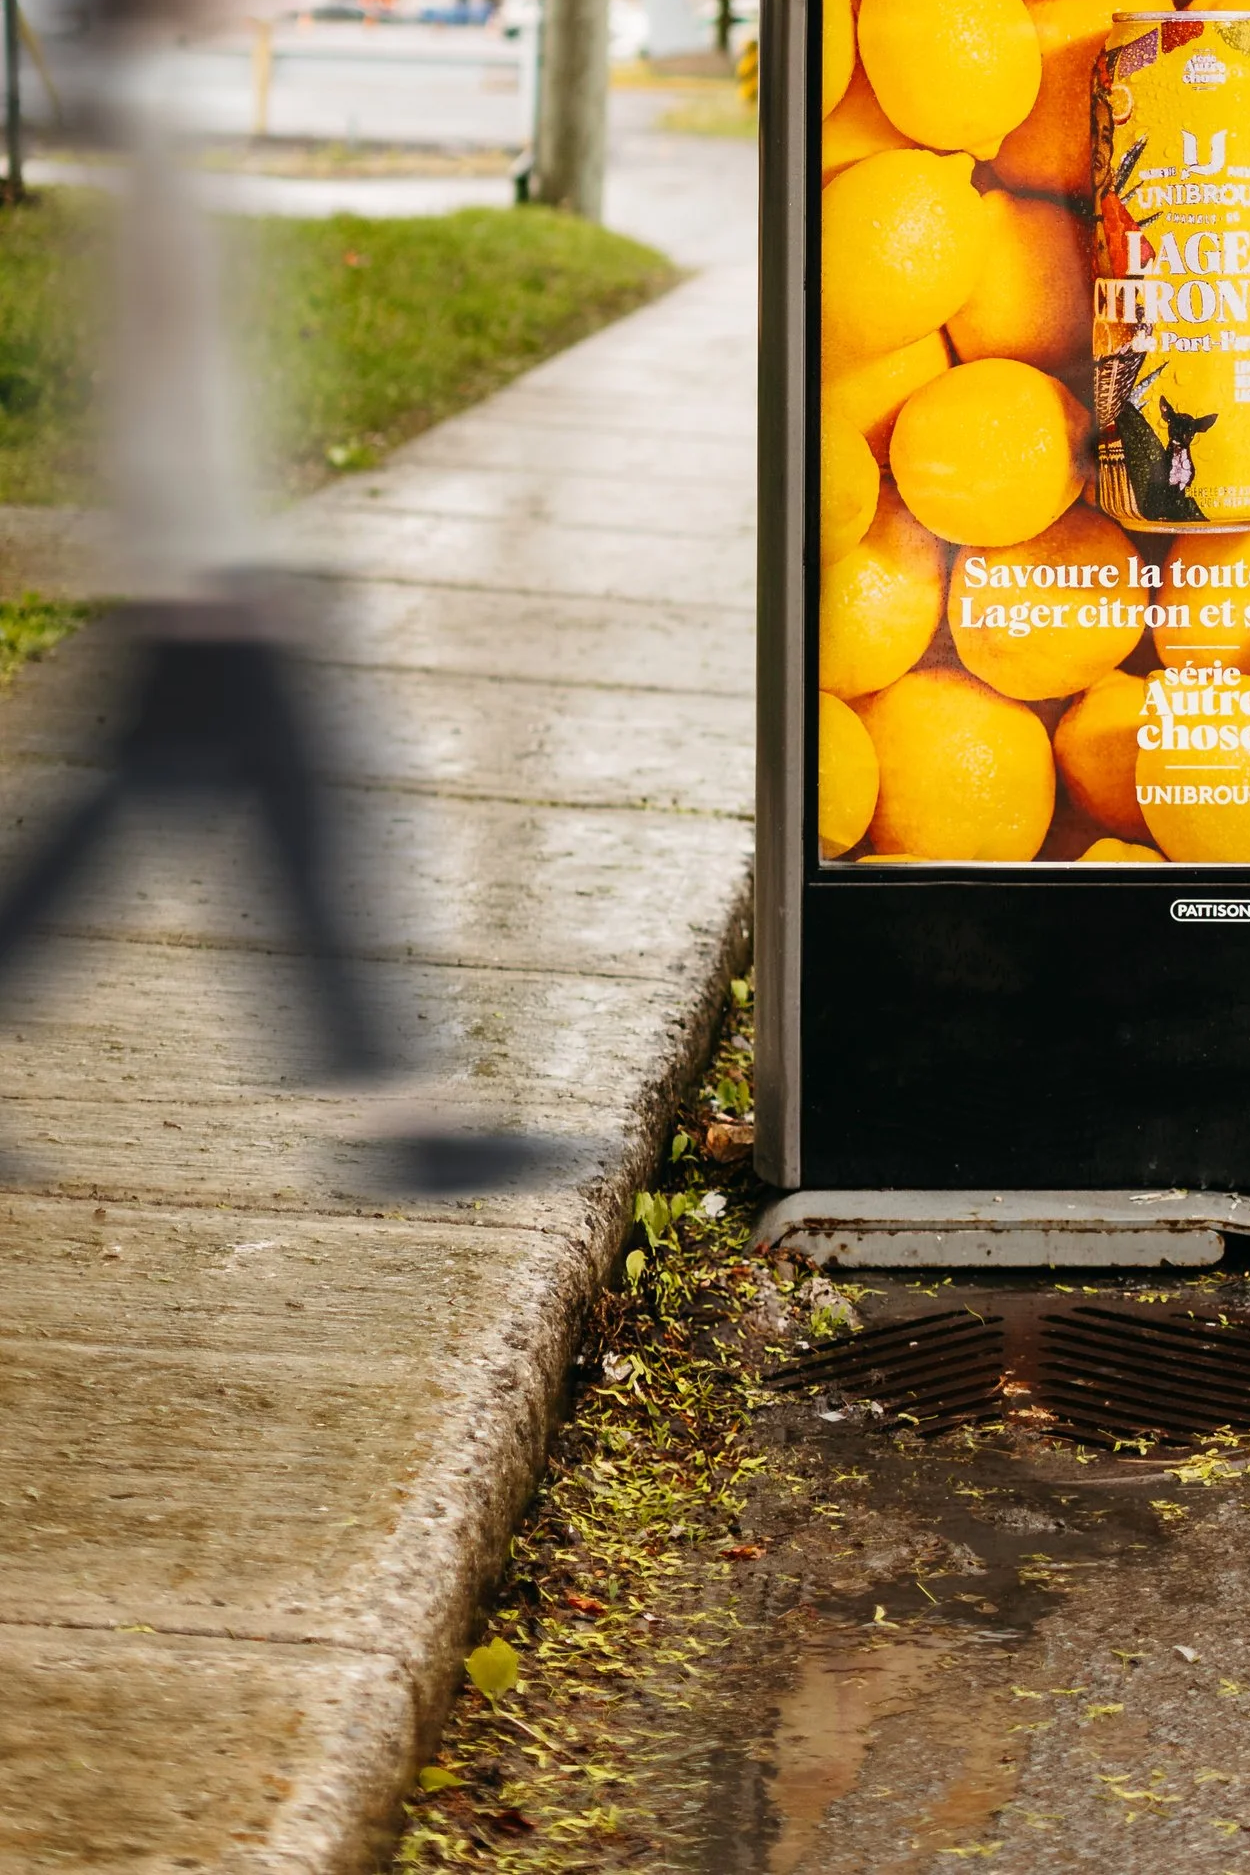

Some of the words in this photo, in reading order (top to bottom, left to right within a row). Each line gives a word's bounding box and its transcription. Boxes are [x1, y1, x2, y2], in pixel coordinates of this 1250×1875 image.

[964, 556, 1119, 589] Savoure
[1128, 556, 1164, 589] la
[960, 597, 1070, 638] Lager
[1077, 596, 1191, 629] citron
[1200, 601, 1236, 629] et
[1164, 660, 1242, 687] série
